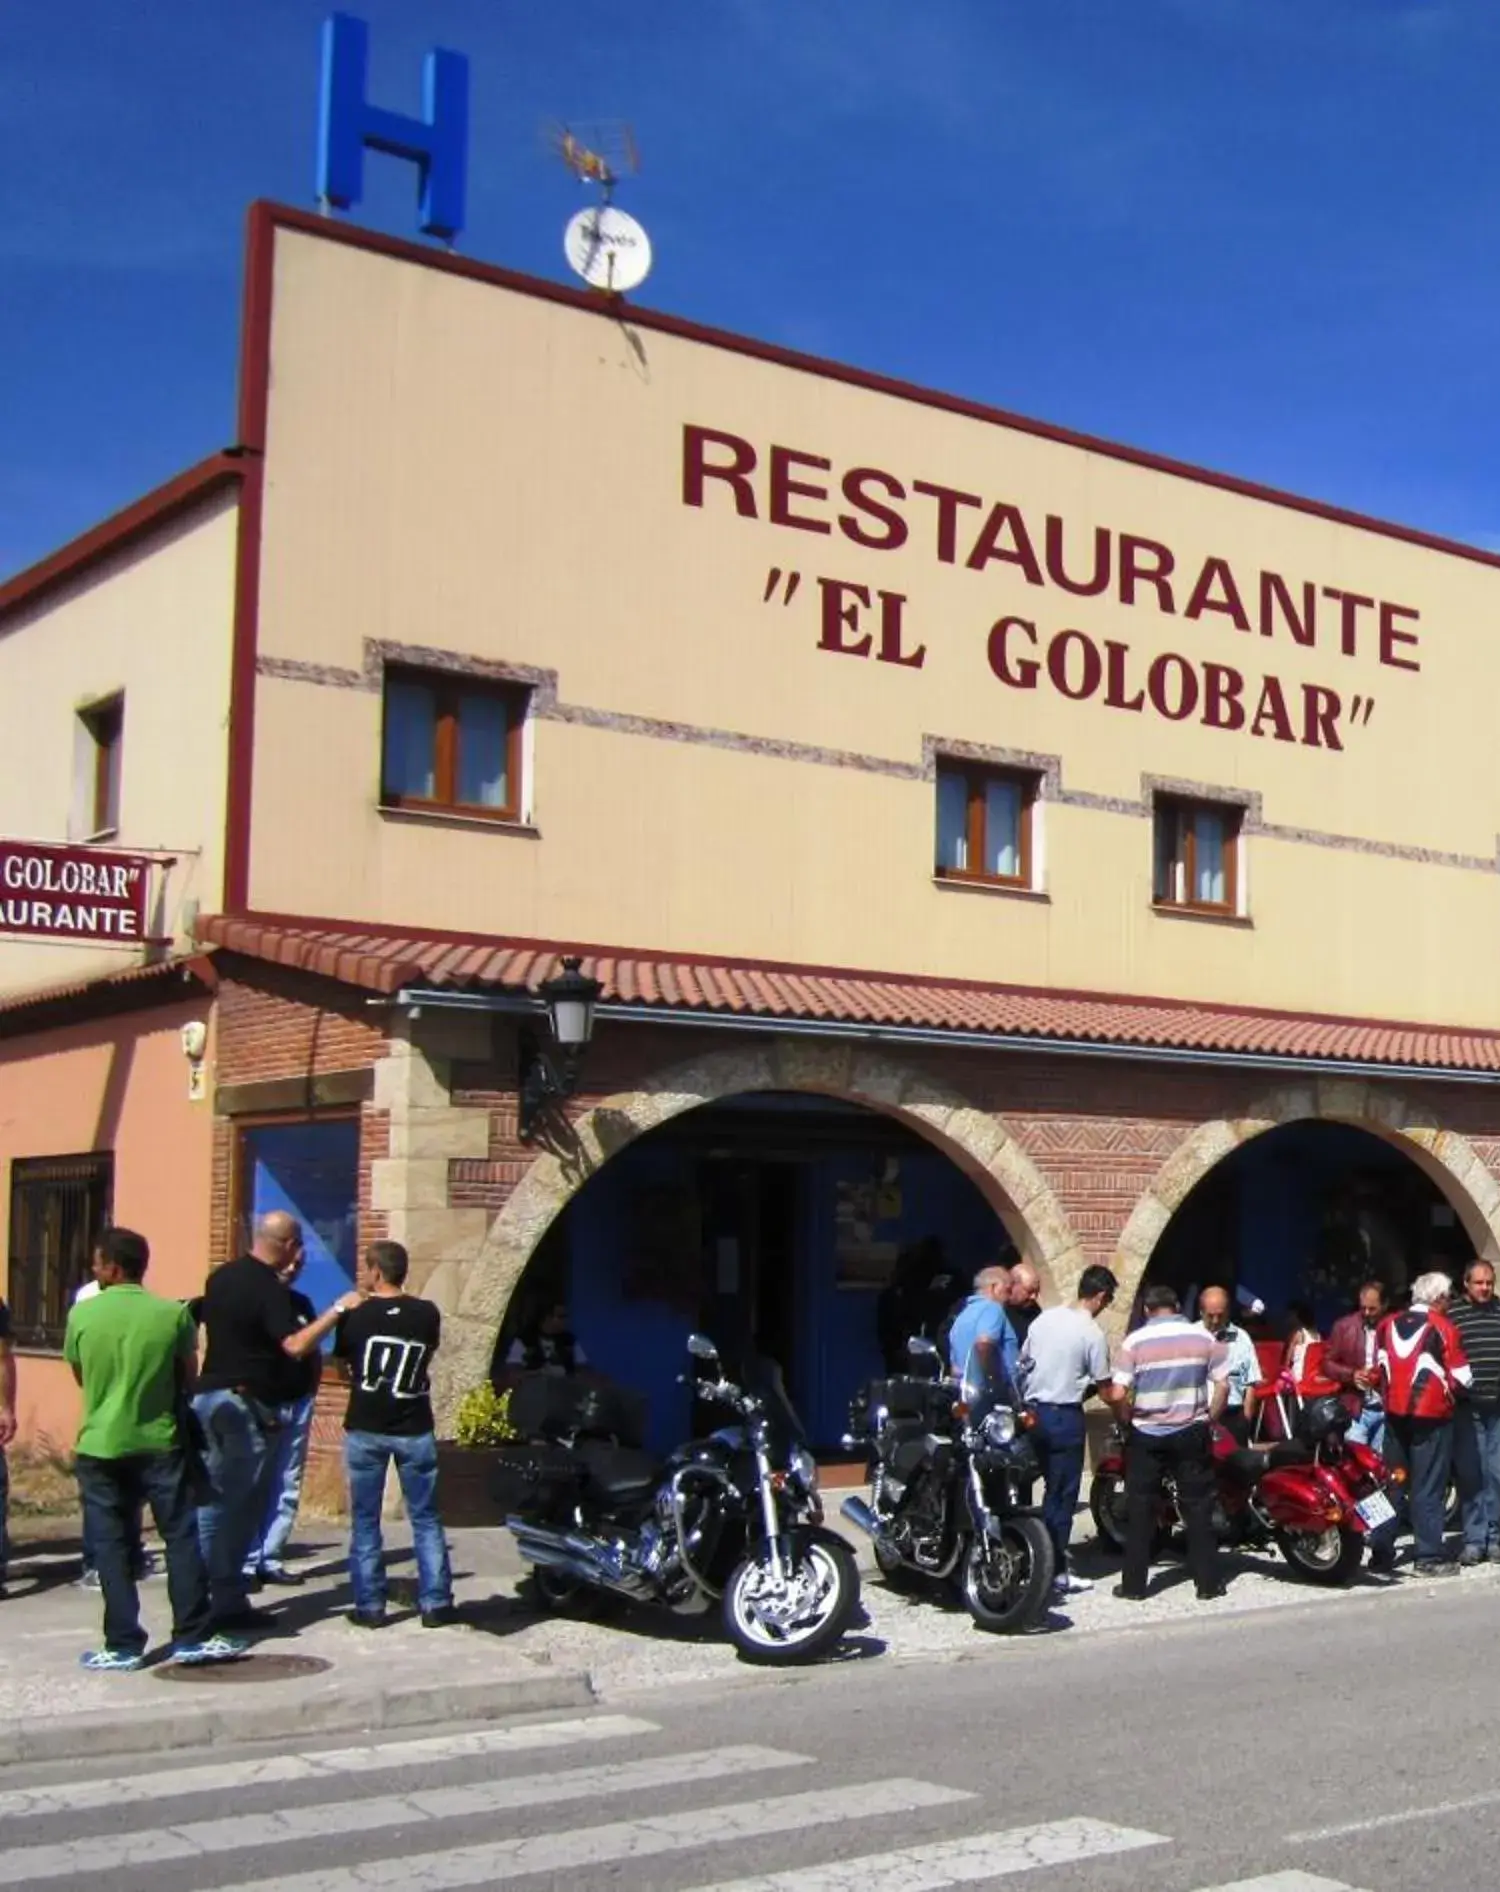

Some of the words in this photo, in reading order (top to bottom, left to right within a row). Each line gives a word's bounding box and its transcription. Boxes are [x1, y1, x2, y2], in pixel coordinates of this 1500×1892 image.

[316, 12, 469, 238] H
[681, 423, 1421, 672] RESTAURANTE
[762, 567, 926, 669] "EL
[986, 616, 1375, 751] GOLOBAR"
[0, 899, 137, 935] URANTE
[5, 855, 140, 898] GOLOBAR"
